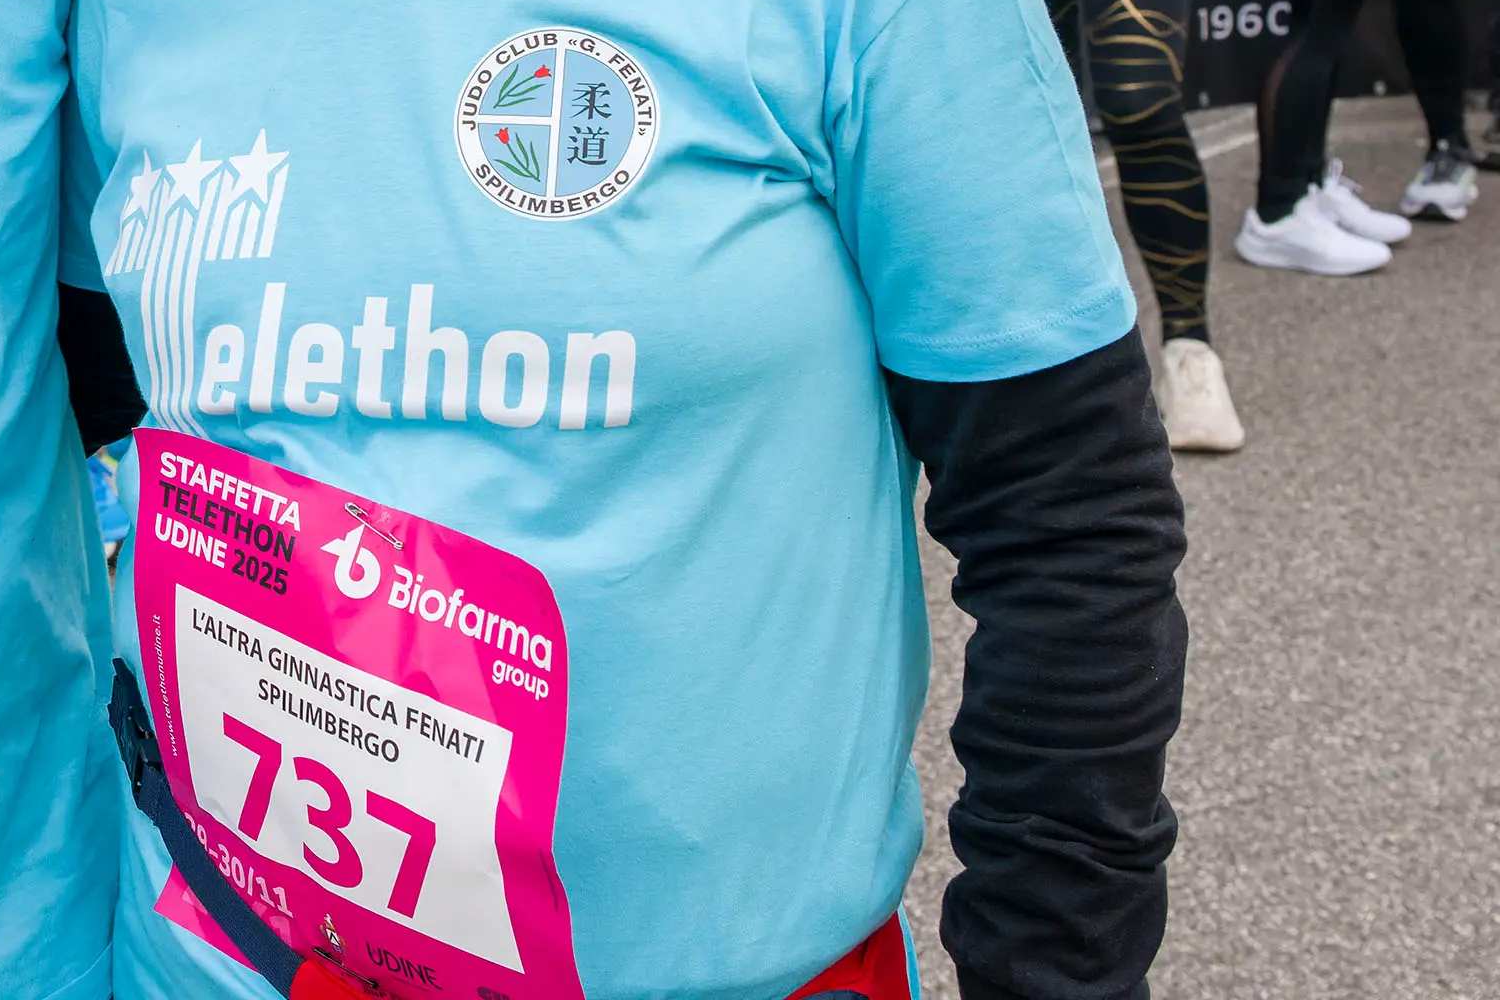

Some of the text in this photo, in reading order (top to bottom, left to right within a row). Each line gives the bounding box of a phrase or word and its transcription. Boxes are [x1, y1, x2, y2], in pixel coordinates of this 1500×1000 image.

[462, 69, 492, 131] JUDO
[495, 33, 558, 66] CLUB
[567, 83, 612, 166] 柔道
[475, 170, 630, 214] SPILIMBERGO
[159, 480, 296, 563] TELETHON
[160, 451, 301, 532] STAFFETTA
[154, 512, 289, 595] UDINE 2025
[387, 564, 553, 672] Biofarma
[152, 614, 178, 757] www.telethonudine.it
[257, 678, 400, 763] SPILIMBERGO
[268, 646, 398, 725] GINNASTICA
[405, 706, 486, 764] FENATI
[491, 659, 549, 700] group
[223, 711, 437, 919] 737
[365, 942, 443, 991] UDINE
